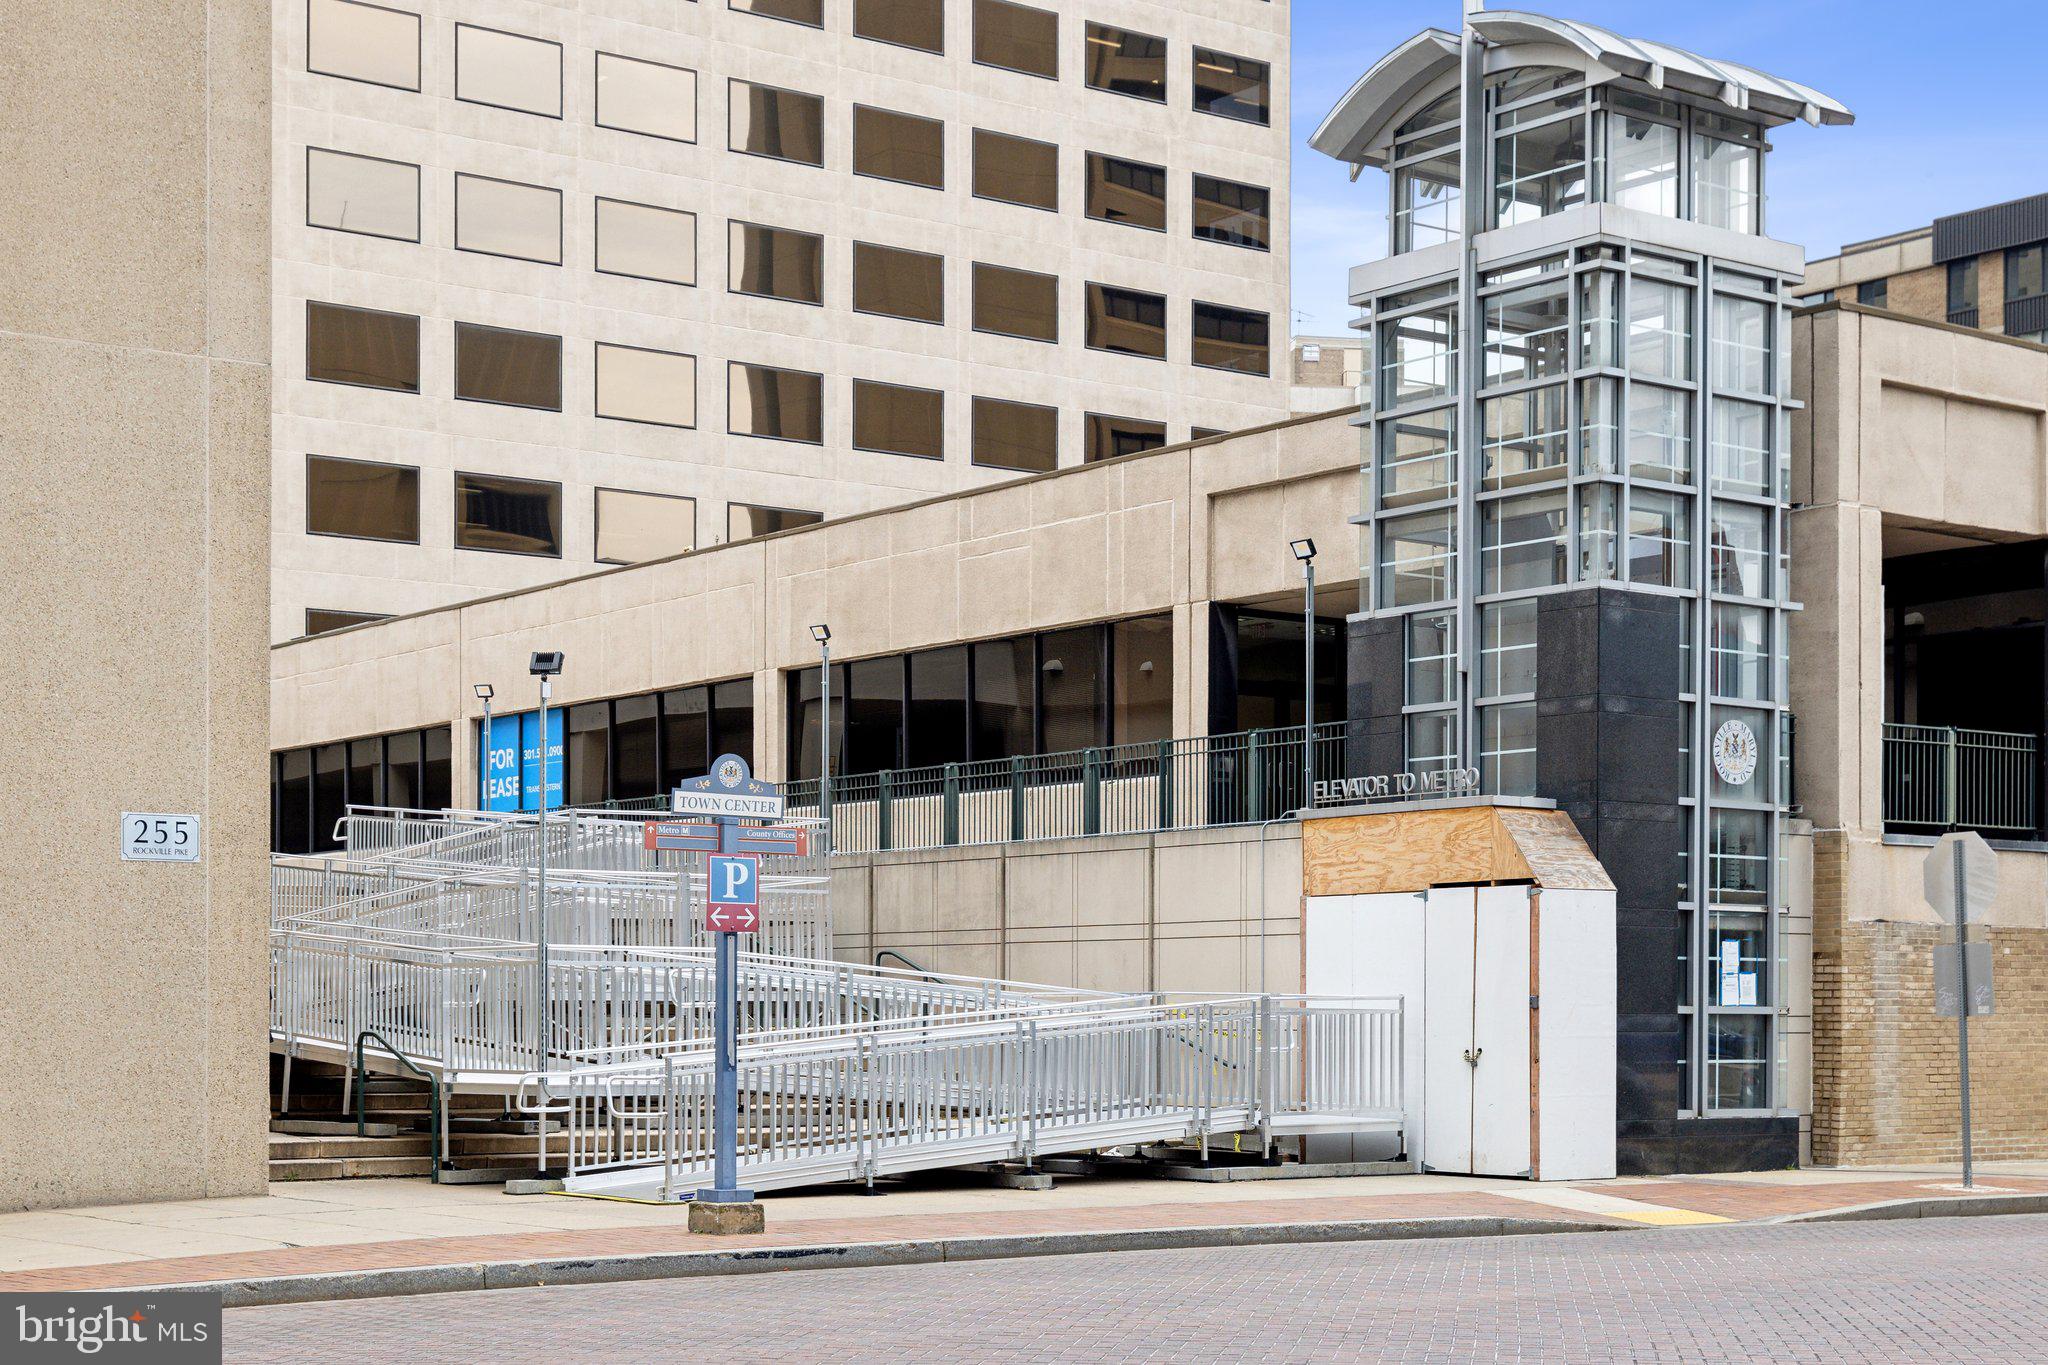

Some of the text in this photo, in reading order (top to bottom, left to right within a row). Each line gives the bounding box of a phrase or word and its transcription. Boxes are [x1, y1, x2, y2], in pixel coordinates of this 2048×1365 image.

[489, 748, 514, 770] FOR
[523, 745, 563, 760] 301.5.0900
[482, 775, 519, 799] LEASE
[526, 782, 561, 793] TRANSSTERN
[1313, 767, 1480, 799] ELEVATOR TO METRO
[679, 796, 777, 814] TOWN CENTER
[133, 820, 188, 844] 255
[658, 826, 680, 834] Metro
[746, 830, 795, 839] County Offices
[132, 847, 188, 856] ROCKVILLE PIKE
[722, 862, 748, 899] P
